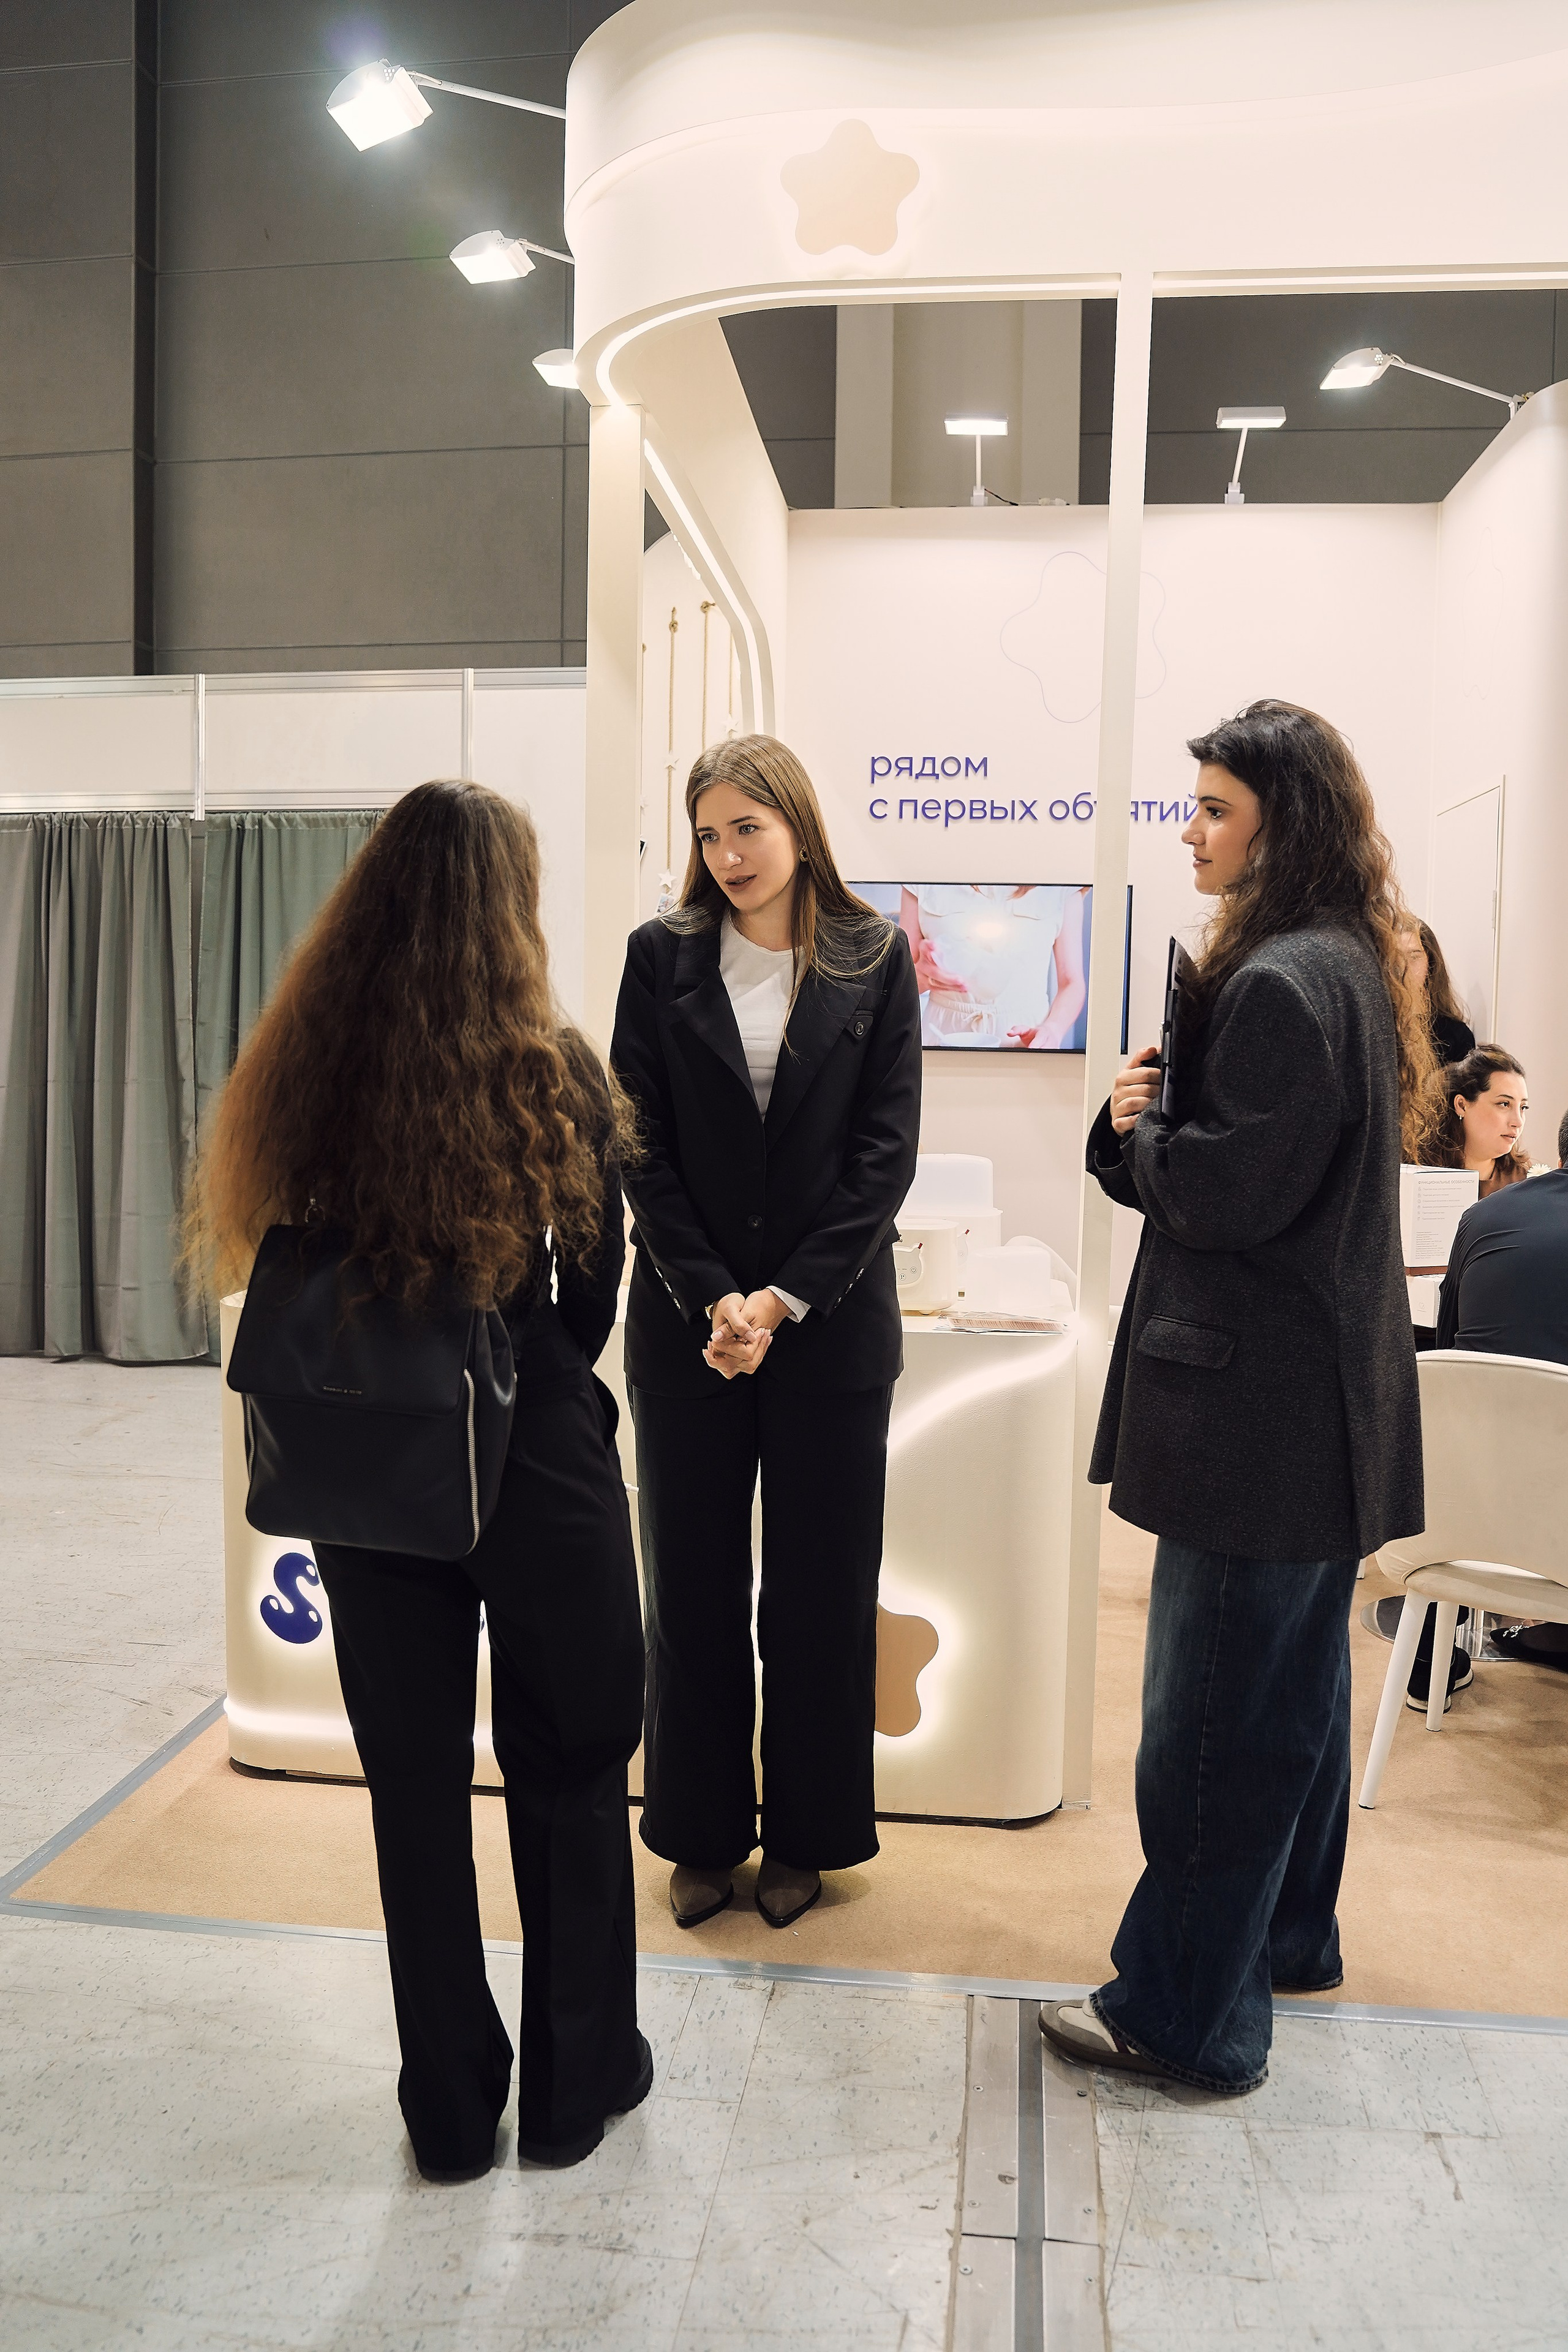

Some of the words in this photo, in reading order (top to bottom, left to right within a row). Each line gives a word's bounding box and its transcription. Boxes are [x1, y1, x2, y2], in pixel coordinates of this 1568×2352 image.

[871, 756, 988, 784] рядом
[869, 798, 888, 820] с
[899, 799, 1038, 827] первых
